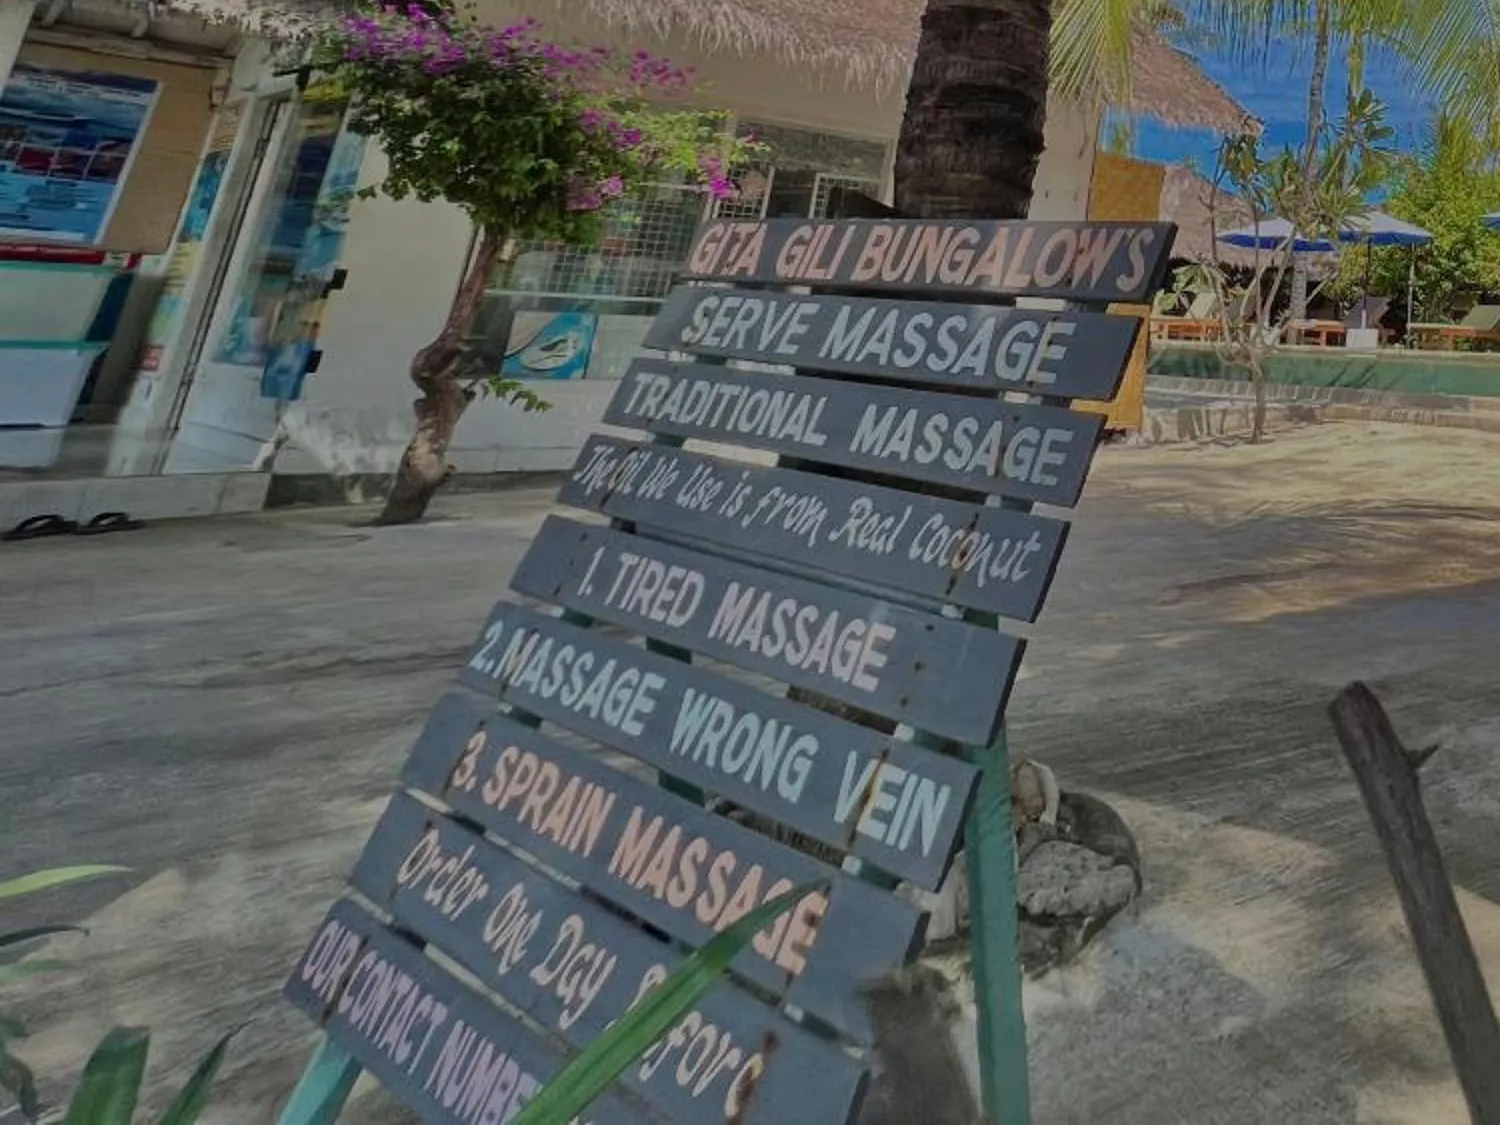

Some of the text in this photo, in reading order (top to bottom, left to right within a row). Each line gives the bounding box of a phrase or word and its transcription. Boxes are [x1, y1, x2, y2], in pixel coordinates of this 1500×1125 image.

[689, 222, 1156, 292] GITA GILI BUNGALOW'S
[681, 295, 1075, 385] SERVE MASSAGE
[624, 372, 1074, 487] TRADITIONAL MASSAGE
[573, 443, 618, 496] The
[637, 455, 680, 500] We
[676, 463, 724, 512] Use
[719, 470, 752, 518] is
[829, 494, 909, 553] Real
[908, 512, 1043, 587] Coconut
[604, 551, 707, 629] TIRED
[707, 582, 897, 694] MASSAGE
[669, 687, 820, 805] WRONG
[832, 749, 952, 859] VEIN
[452, 730, 829, 976] 3. SPRAIN MASSAGE
[301, 919, 545, 1125] OUR CONTACT NUMBE
[397, 826, 490, 922] Order
[482, 881, 544, 975] One
[604, 963, 765, 1120] fore
